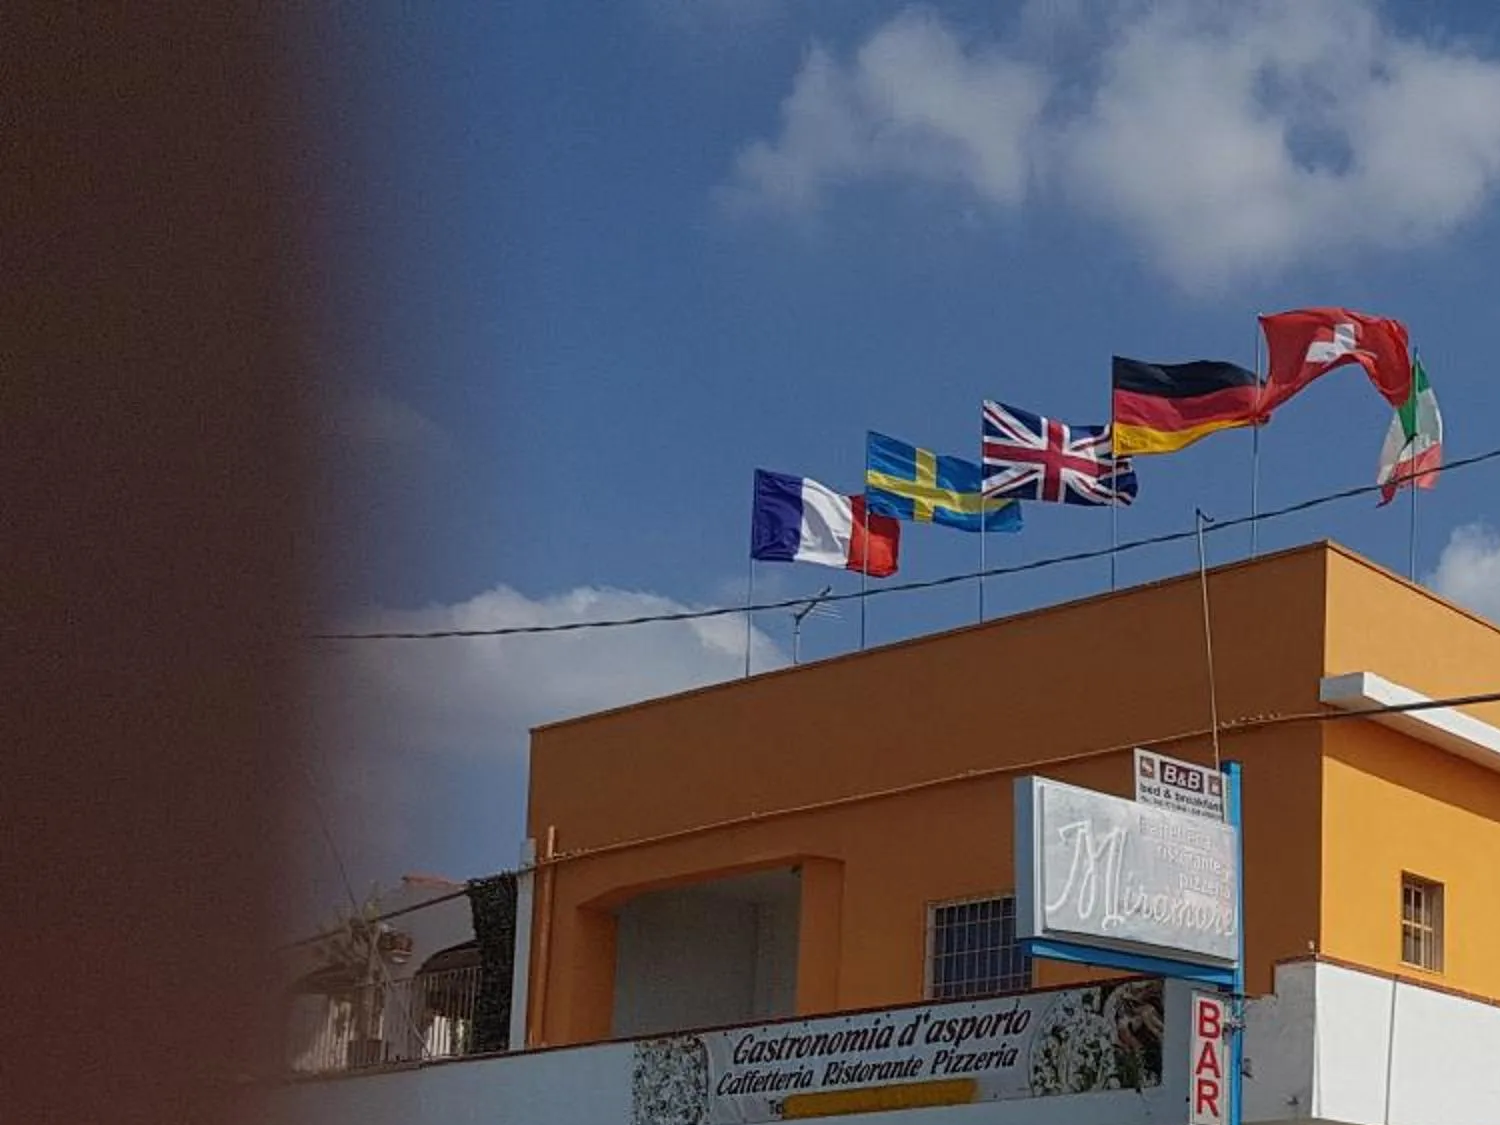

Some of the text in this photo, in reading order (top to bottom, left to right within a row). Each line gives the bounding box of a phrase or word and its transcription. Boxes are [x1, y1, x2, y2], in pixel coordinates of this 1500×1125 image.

[1164, 764, 1201, 790] B&B
[732, 1007, 1032, 1065] Gastronomia d'asporto
[1196, 999, 1221, 1118] BAR
[716, 1043, 1019, 1097] Caffetteria Ristorante Pizzeria
